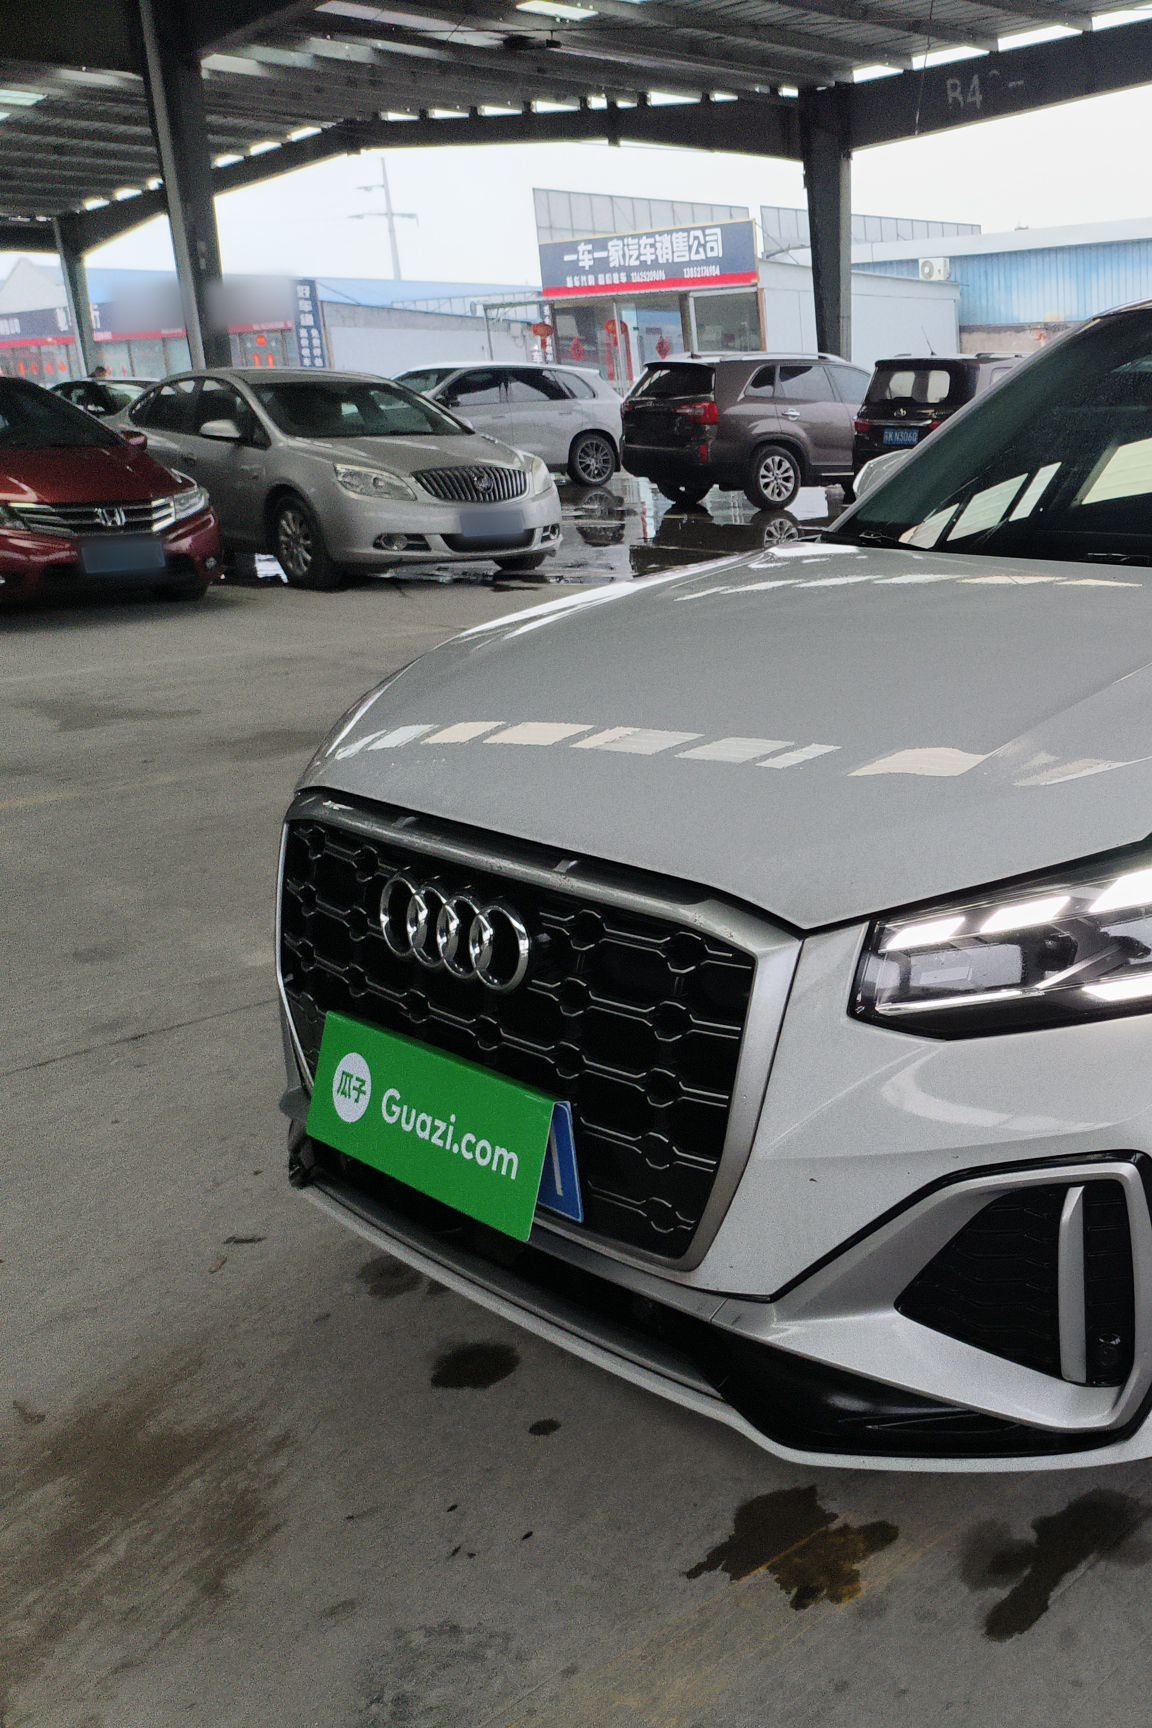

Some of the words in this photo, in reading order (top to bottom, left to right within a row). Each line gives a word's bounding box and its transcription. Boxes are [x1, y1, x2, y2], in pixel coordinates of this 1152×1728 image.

[563, 227, 723, 271] 一车一家汽车销售公司
[337, 1071, 366, 1104] 瓜子
[381, 1087, 519, 1180] Guazi.com
